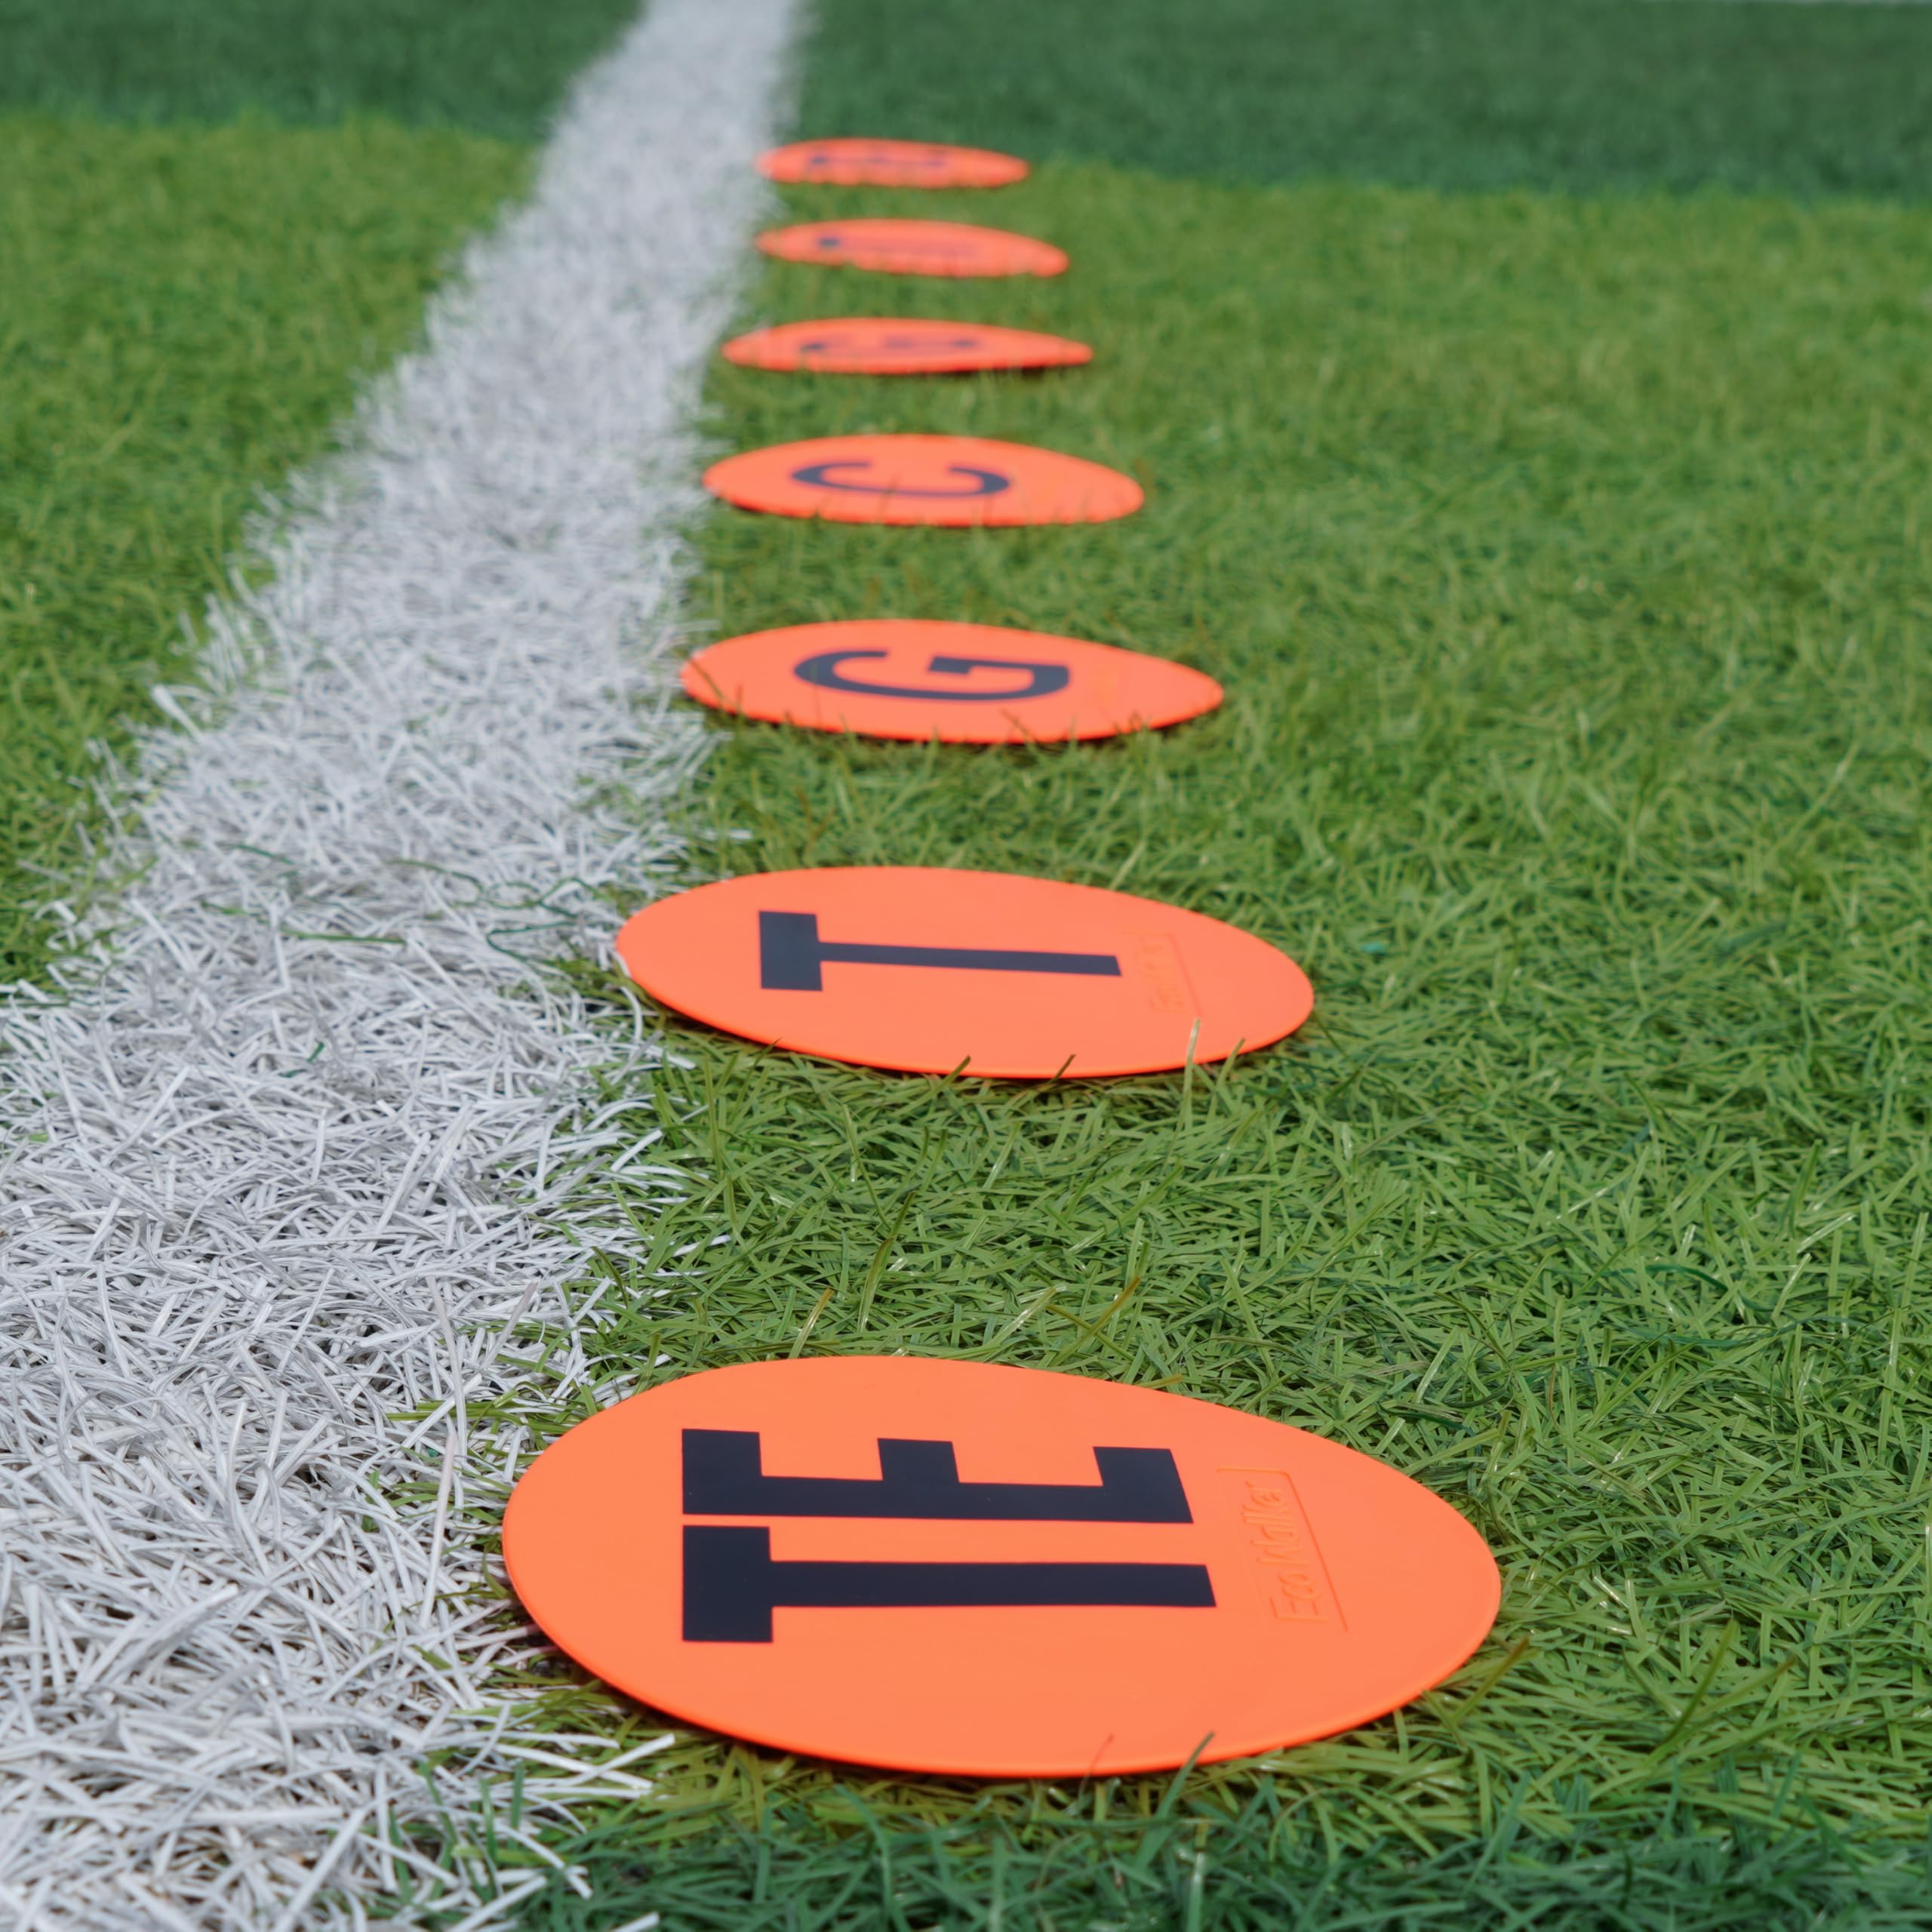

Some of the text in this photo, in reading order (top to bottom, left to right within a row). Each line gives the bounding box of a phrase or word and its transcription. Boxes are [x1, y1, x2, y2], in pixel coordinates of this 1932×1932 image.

[791, 462, 1010, 497] C
[792, 650, 1070, 701] G
[758, 909, 1122, 992] T
[681, 1428, 1217, 1643] TE
